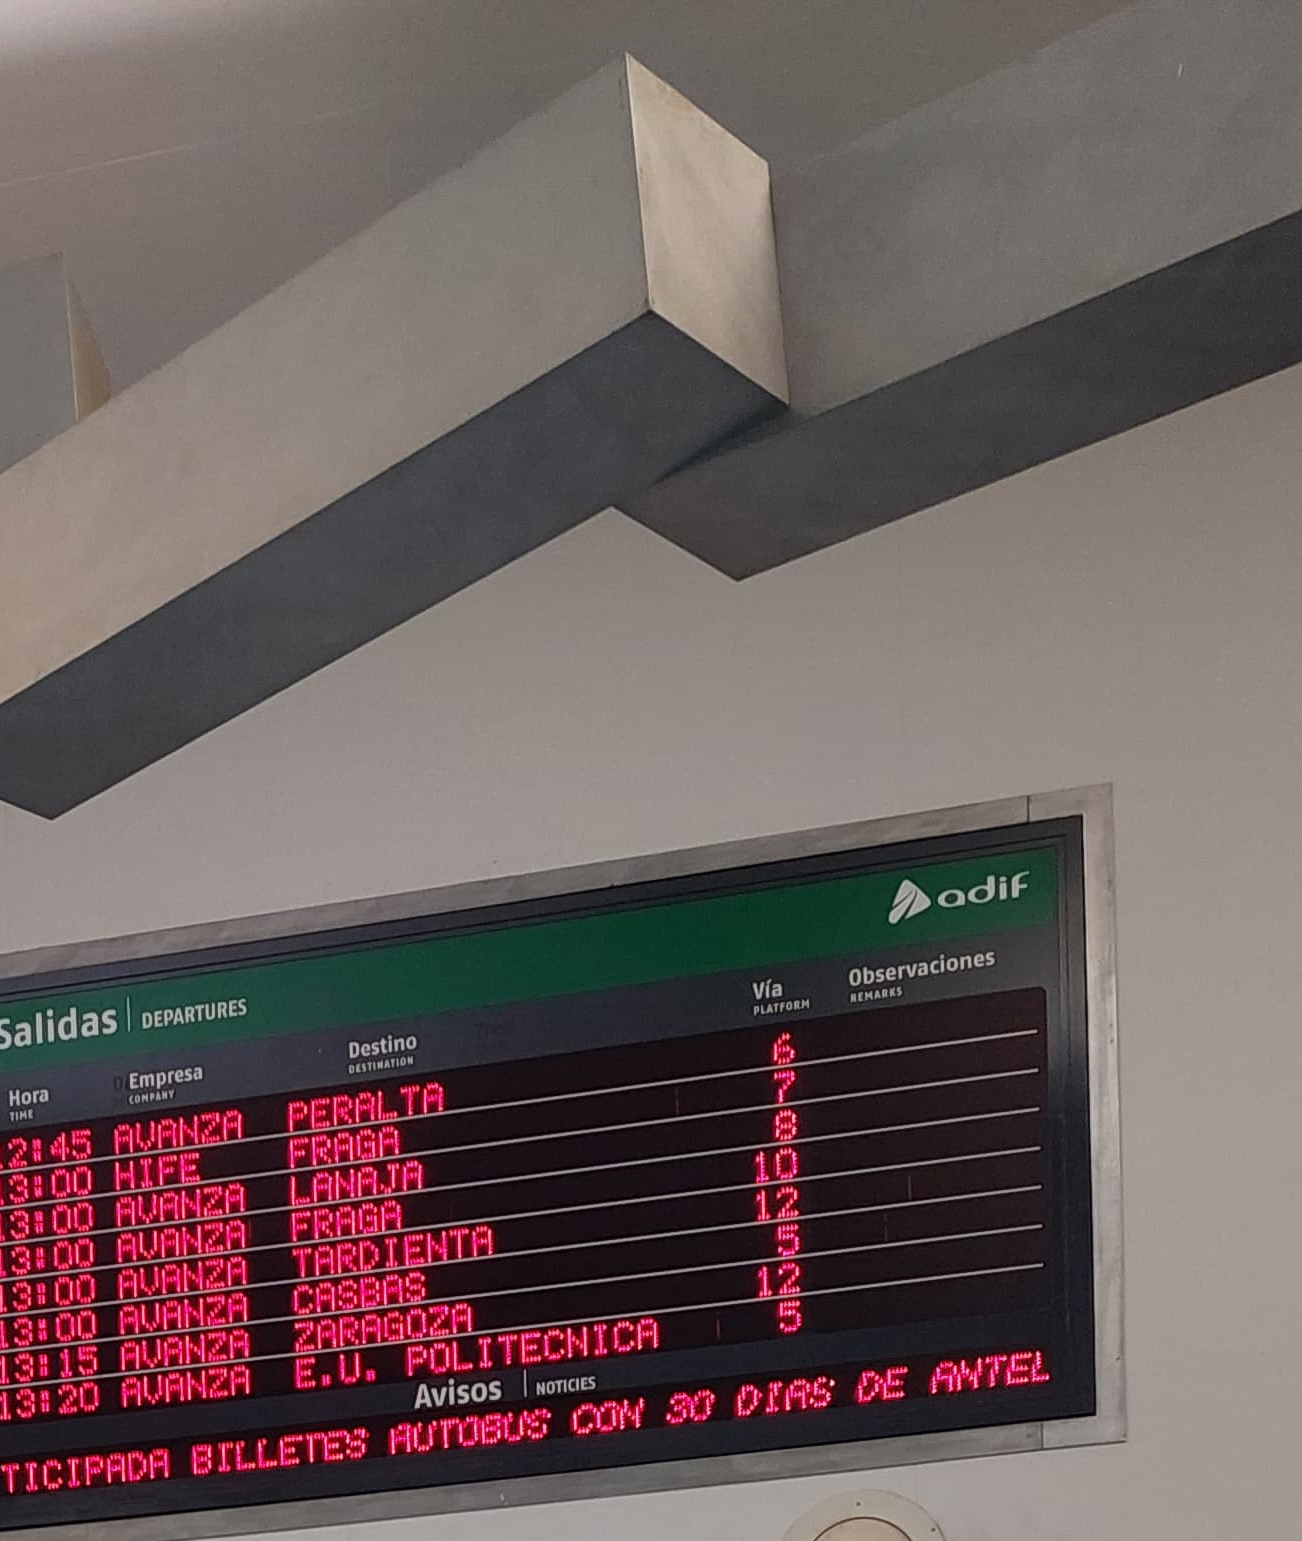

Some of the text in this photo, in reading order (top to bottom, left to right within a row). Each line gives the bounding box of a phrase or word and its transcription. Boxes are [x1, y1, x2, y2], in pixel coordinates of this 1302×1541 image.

[938, 871, 1031, 908] adif
[849, 949, 997, 988] Observaciones
[752, 979, 784, 1001] Vía
[753, 998, 811, 1016] PLATFORM
[850, 986, 904, 1004] REMARKS
[141, 998, 248, 1030] DEPARTURES
[348, 1033, 418, 1059] Destino
[129, 1066, 204, 1090] Empresa
[348, 1056, 415, 1075] DESTINATION
[8, 1086, 50, 1107] Hora
[113, 1108, 244, 1156] AVANZA
[286, 1081, 445, 1133] PERALTA
[771, 1032, 796, 1067] 6
[128, 1089, 176, 1105] COMPANY
[9, 1109, 34, 1122] TIME
[113, 1151, 202, 1192] HIFE
[287, 1124, 401, 1171] FRAGA
[773, 1069, 797, 1105] 7
[114, 1182, 247, 1228] AVANZA
[288, 1159, 425, 1207] LANAJA
[772, 1108, 798, 1143] 8
[115, 1218, 248, 1265] AVANZA
[289, 1199, 403, 1243] FRAGA
[754, 1146, 799, 1185] 10
[117, 1255, 249, 1300] AVANZA
[291, 1224, 495, 1280] TARDIENTA
[755, 1185, 800, 1223] 12
[117, 1291, 250, 1337] AVANZA
[291, 1269, 427, 1317] CASBAS
[774, 1222, 801, 1258] 5
[119, 1327, 251, 1372] AVANZA
[293, 1302, 474, 1353] ZARAGOZA
[757, 1261, 802, 1299] 12
[120, 1364, 251, 1408] AVANZA
[294, 1351, 377, 1390] E.U.
[404, 1317, 660, 1377] POLITECNICA
[776, 1299, 803, 1334] 5
[413, 1375, 597, 1411] Avisos NOTICIES
[0, 1351, 1050, 1494] TICIPADA BILLETES AUTOBUS CON 30 DIAS DE ANTEL
